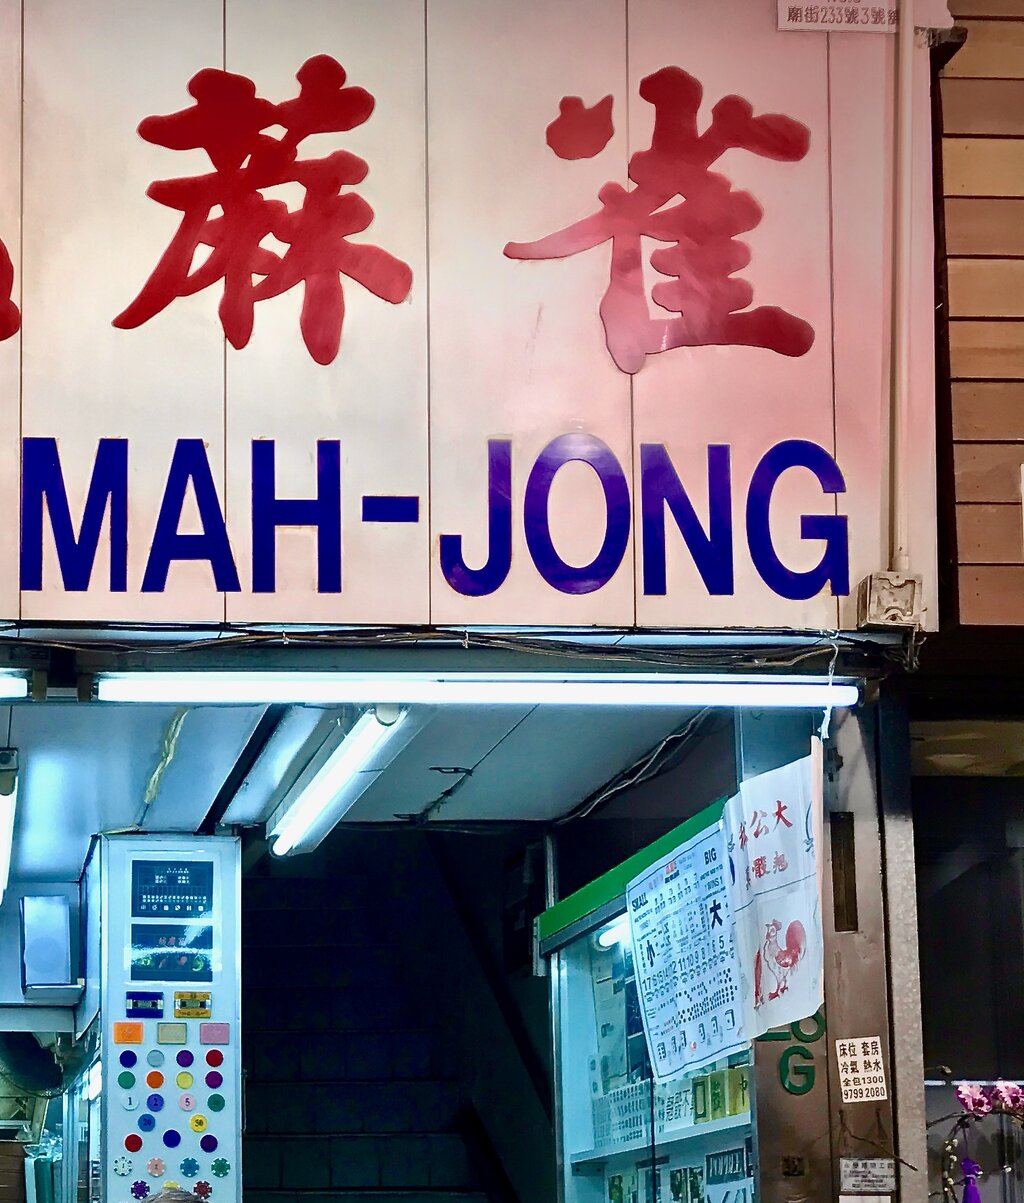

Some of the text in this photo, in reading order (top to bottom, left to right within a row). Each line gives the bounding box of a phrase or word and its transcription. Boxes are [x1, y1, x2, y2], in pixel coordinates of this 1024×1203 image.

[20, 433, 850, 601] MAH-JONG
[703, 847, 717, 866] BIG
[709, 898, 724, 930] 大
[719, 934, 725, 949] 5
[861, 1041, 879, 1056] 套房
[780, 1045, 816, 1096] G
[843, 1086, 885, 1100] 9799 2080
